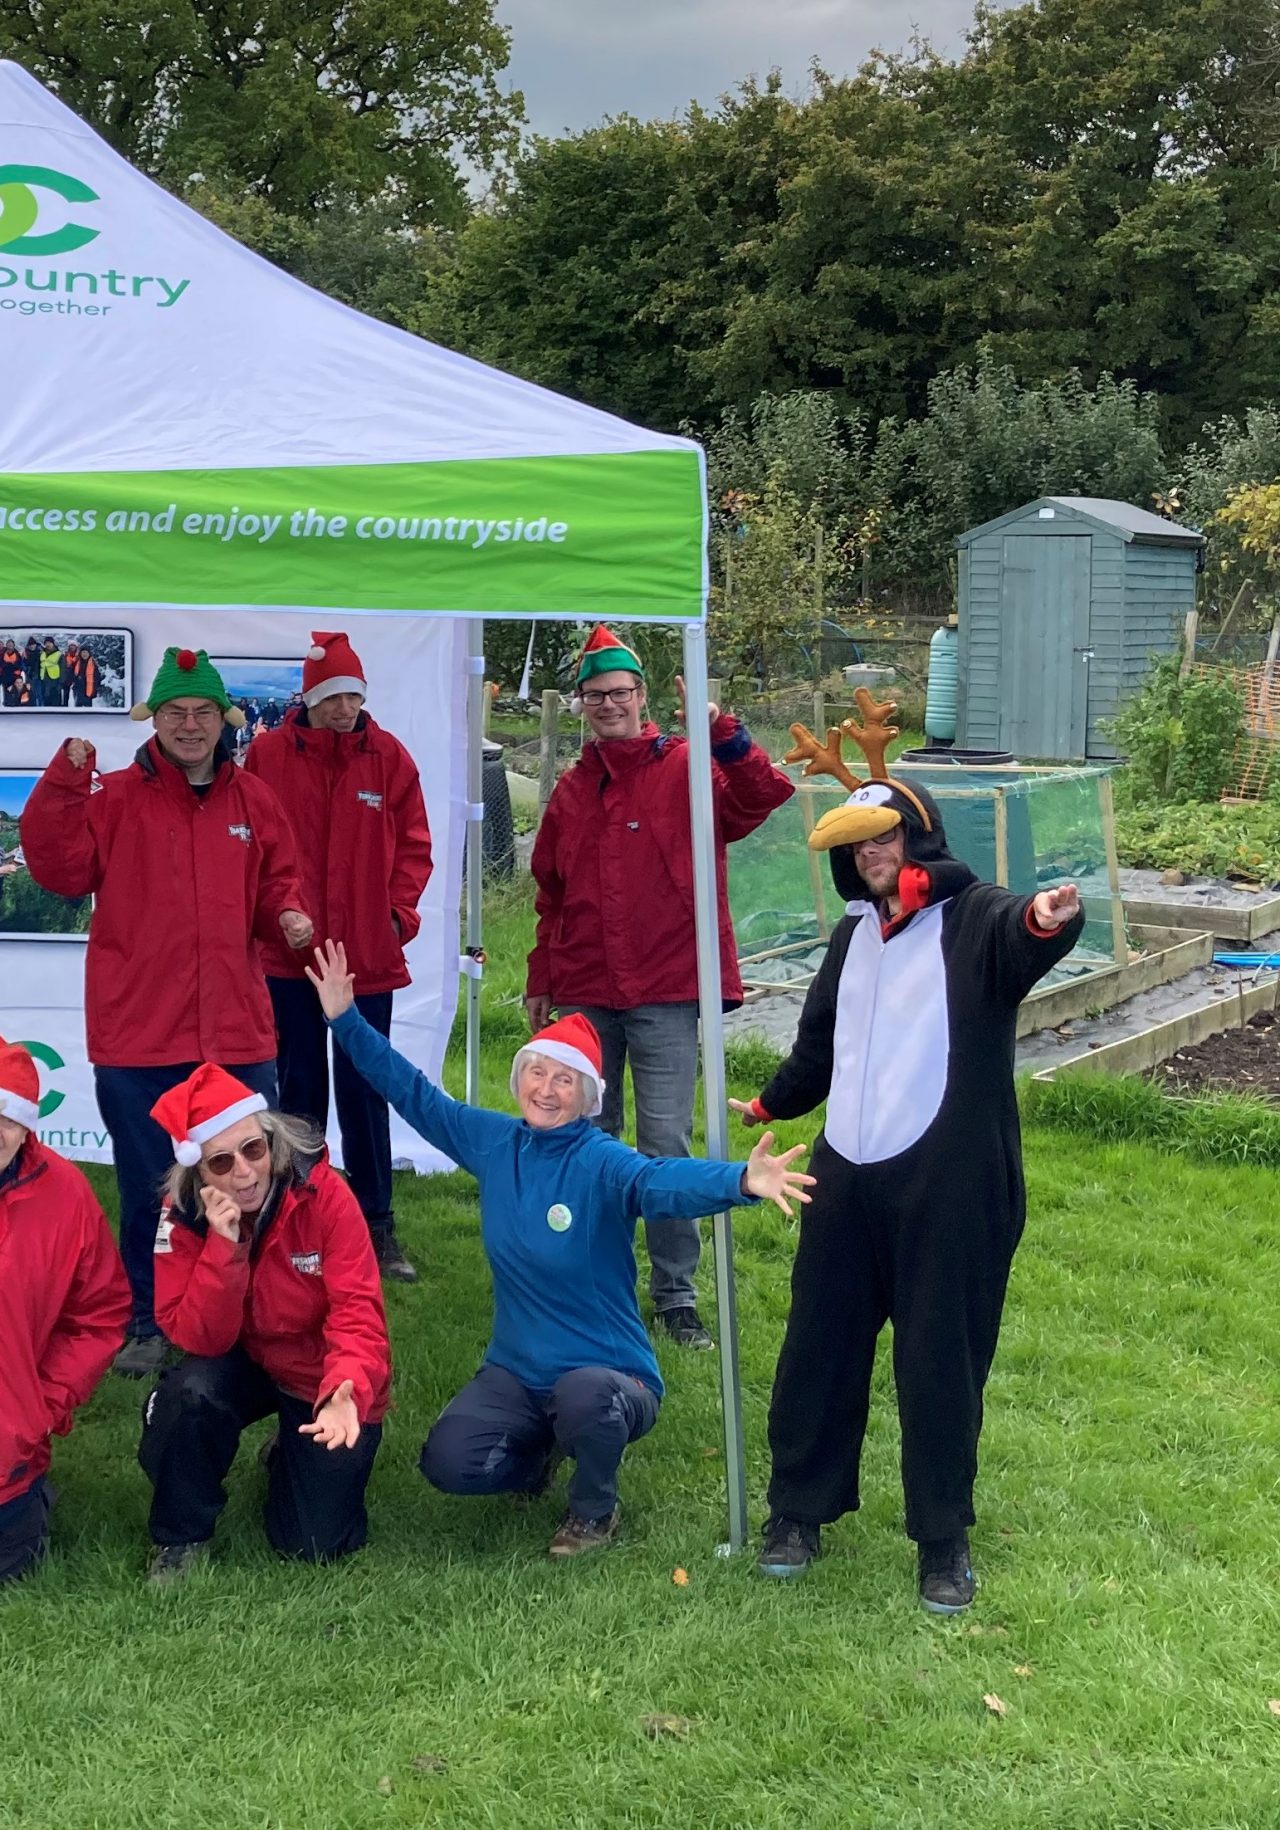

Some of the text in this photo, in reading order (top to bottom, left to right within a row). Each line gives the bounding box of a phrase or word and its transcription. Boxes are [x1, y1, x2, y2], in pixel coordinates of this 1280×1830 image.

[105, 504, 176, 532] and
[182, 506, 282, 543] enjoy
[289, 508, 348, 538] the
[355, 516, 568, 549] countryside
